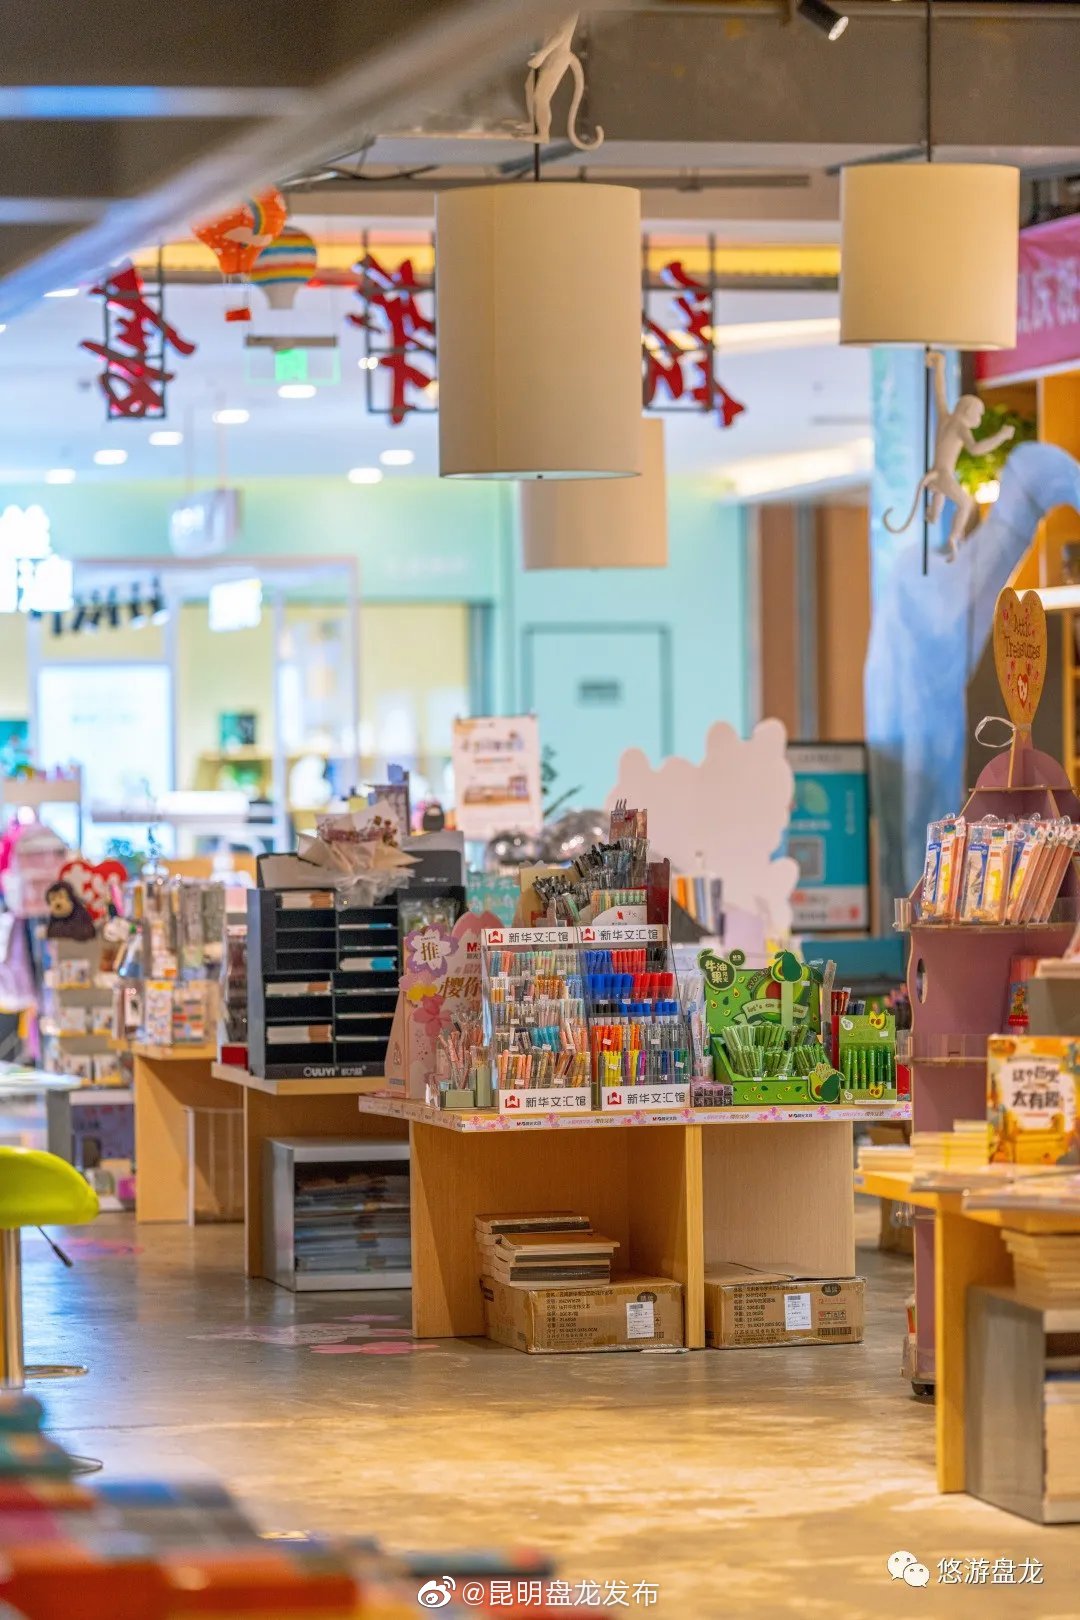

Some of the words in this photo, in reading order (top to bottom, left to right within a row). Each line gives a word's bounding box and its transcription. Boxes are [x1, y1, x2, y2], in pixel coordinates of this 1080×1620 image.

[508, 931, 569, 943] 新华文汇馆
[600, 928, 658, 941] 新华文汇馆
[525, 1095, 587, 1108] 新华文汇馆
[627, 1091, 686, 1105] 新华文汇馆
